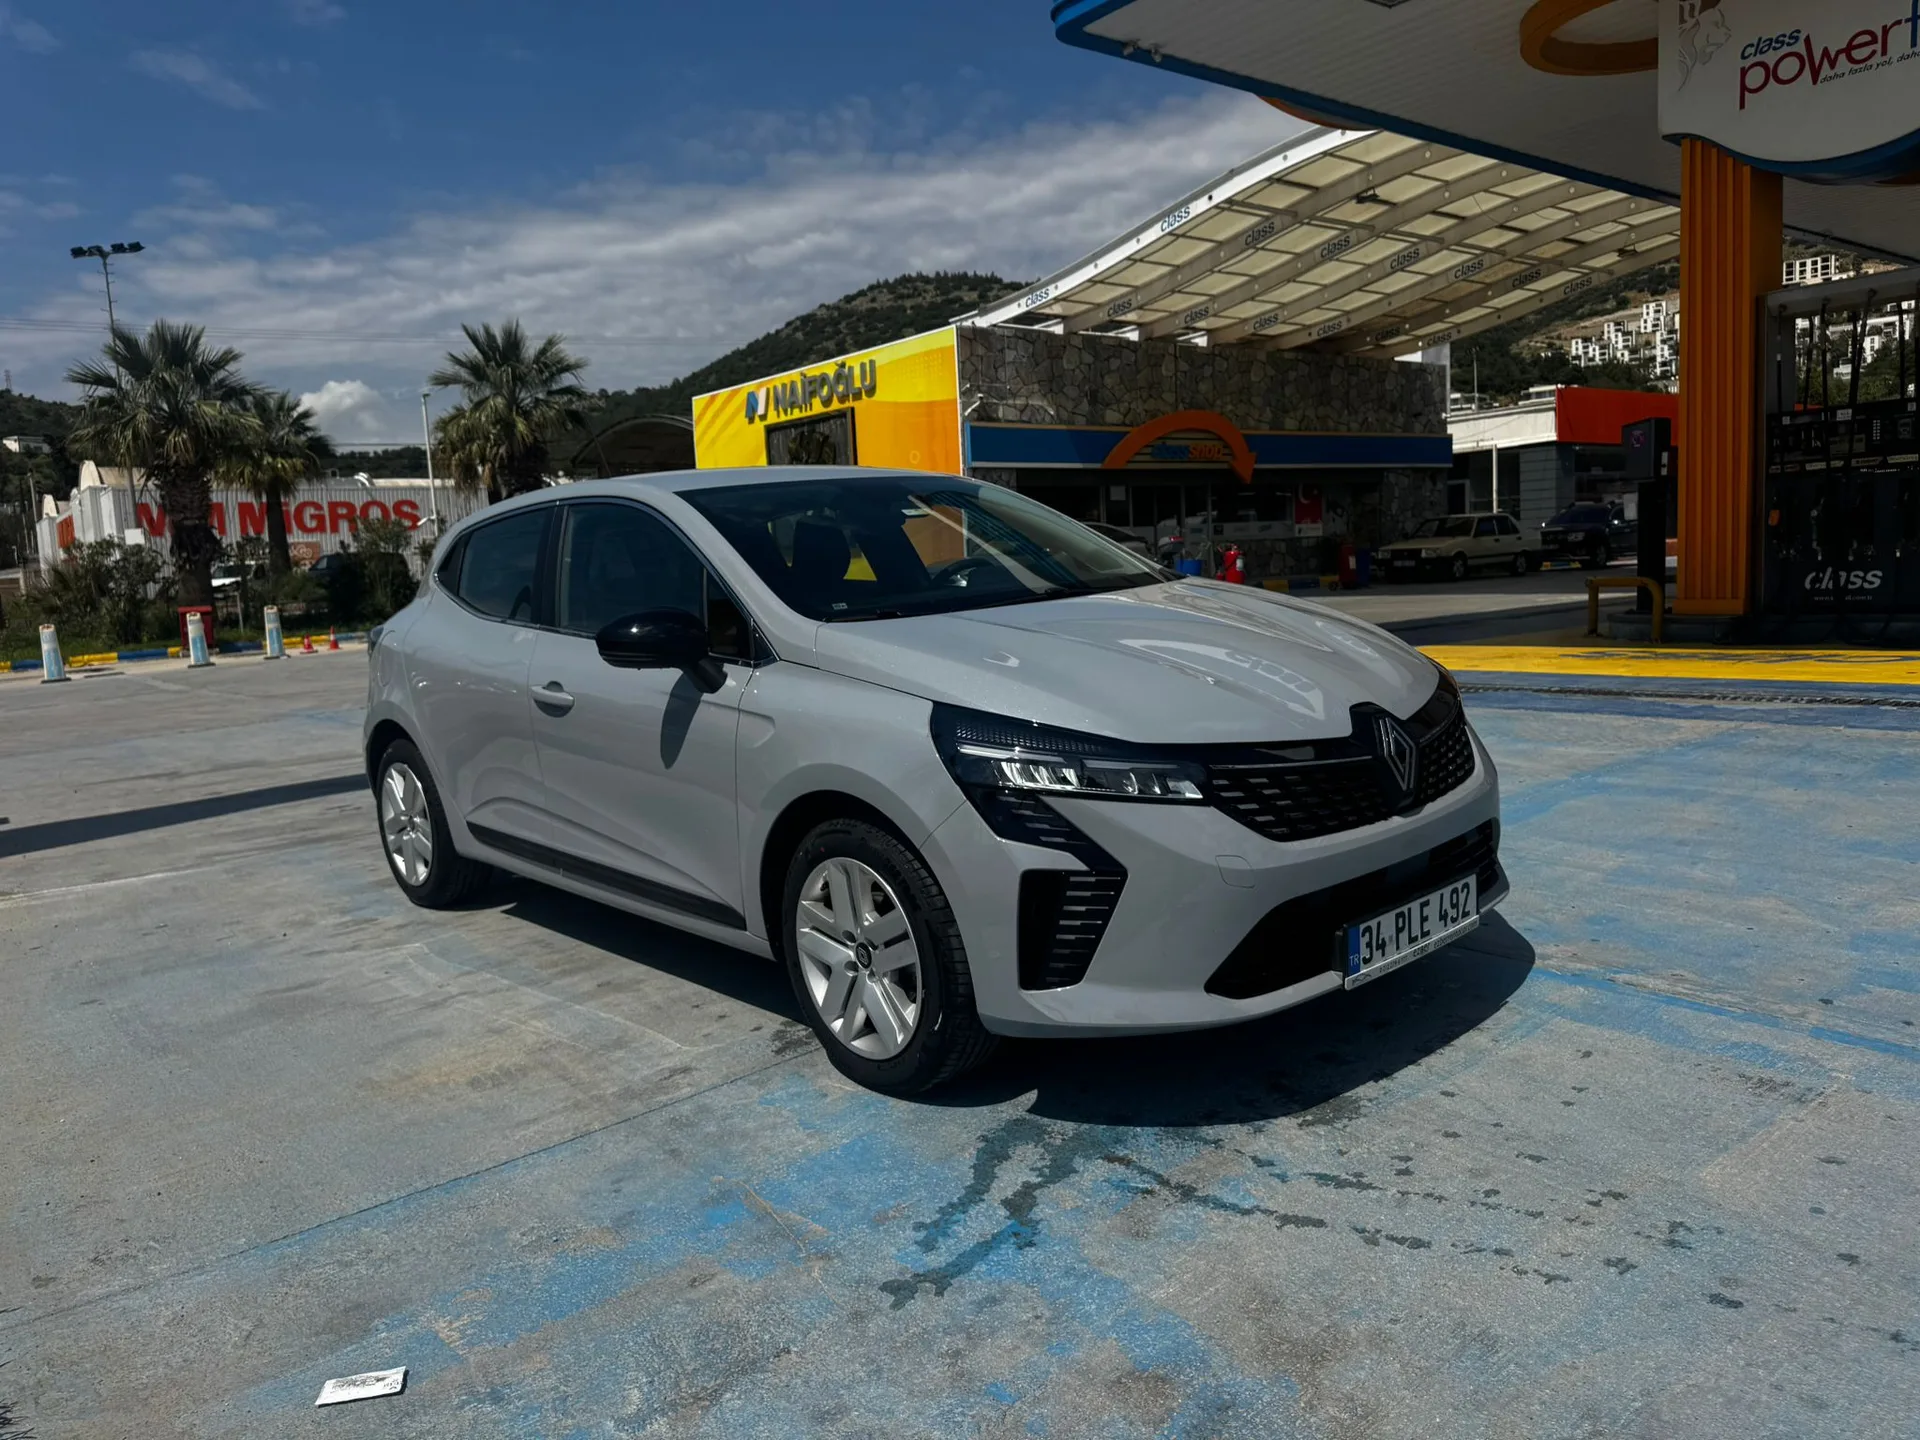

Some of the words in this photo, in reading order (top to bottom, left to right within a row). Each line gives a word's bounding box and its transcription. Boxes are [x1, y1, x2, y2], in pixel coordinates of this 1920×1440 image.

[1740, 29, 1802, 60] class
[1819, 71, 1845, 84] daha
[1847, 62, 1873, 76] fazla
[1160, 205, 1191, 233] class
[1244, 221, 1275, 246] class
[1319, 235, 1350, 259] class
[1389, 247, 1420, 270] class
[1454, 257, 1484, 280] class
[1512, 267, 1541, 289] class
[1563, 275, 1593, 296] class
[1025, 287, 1050, 309] class
[1107, 297, 1132, 318] class
[1184, 305, 1209, 325] class
[1253, 312, 1279, 331] class
[1317, 319, 1342, 338] class
[1375, 325, 1400, 343] class
[1426, 331, 1452, 347] class
[1349, 954, 1360, 967] TR
[1361, 920, 1387, 965] 34
[1395, 898, 1431, 952] PLE
[1438, 882, 1470, 928] 492
